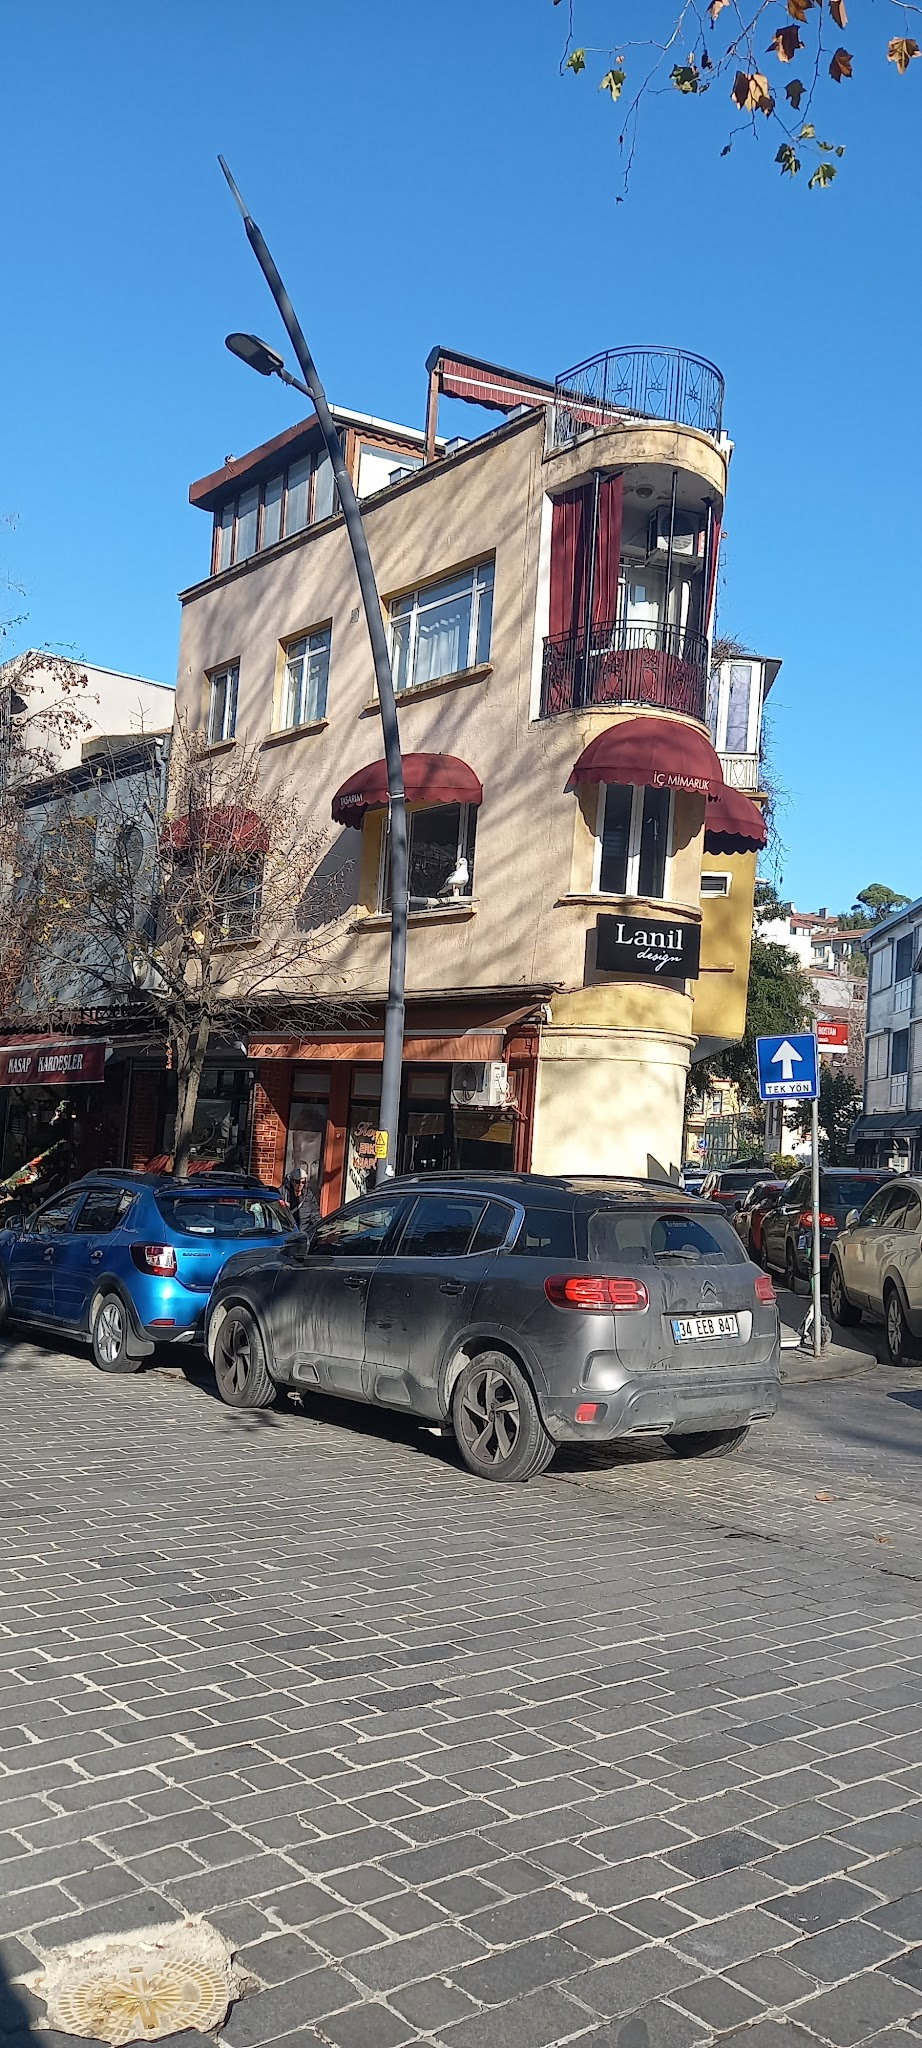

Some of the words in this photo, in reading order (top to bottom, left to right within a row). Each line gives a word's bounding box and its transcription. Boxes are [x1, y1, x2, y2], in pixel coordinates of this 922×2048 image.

[653, 771, 665, 786] İÇ
[668, 773, 710, 790] MİMARLIK
[614, 922, 684, 951] Lanil
[636, 947, 683, 973] design
[818, 1026, 837, 1036] BOSTAN
[7, 1057, 32, 1074] KASAP
[37, 1053, 84, 1075] KARDEŞLER
[767, 1085, 786, 1094] TEK
[789, 1083, 810, 1092] YÖN
[679, 1321, 693, 1337] 34
[696, 1319, 715, 1335] EEB
[718, 1316, 735, 1333] 847
